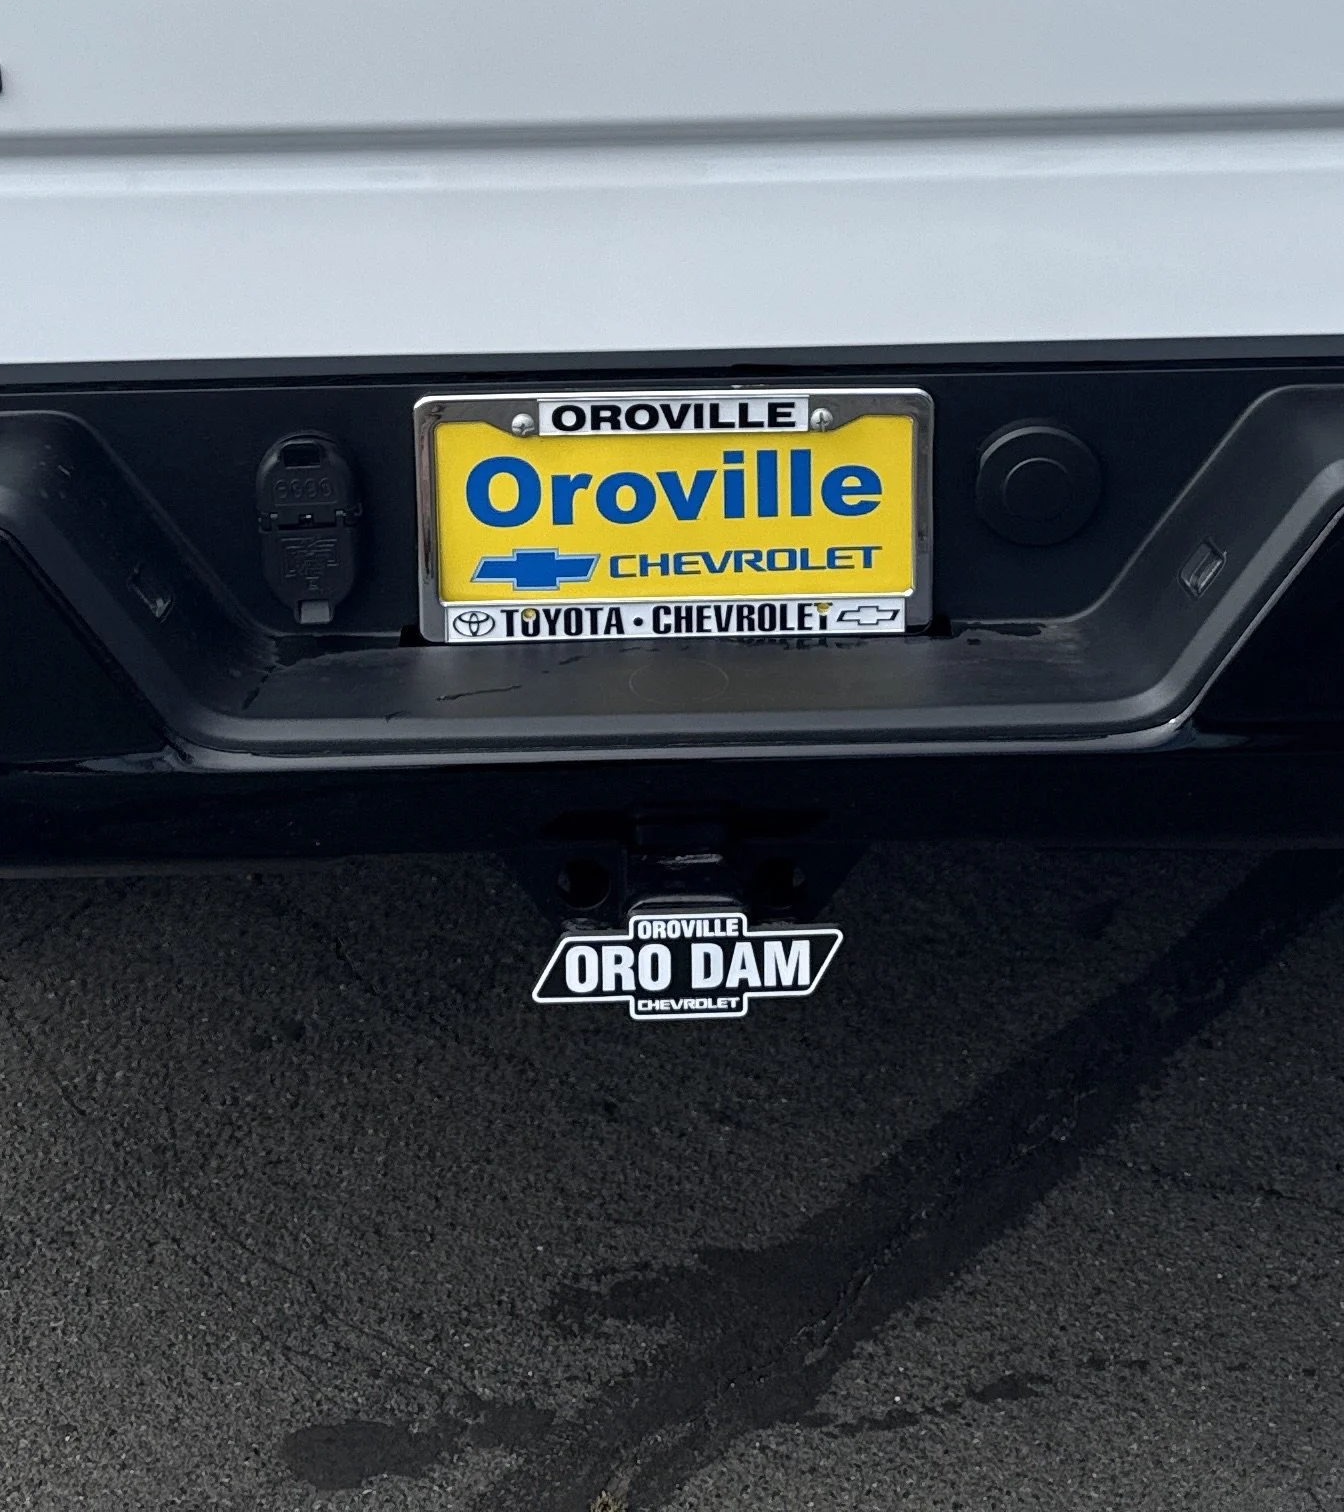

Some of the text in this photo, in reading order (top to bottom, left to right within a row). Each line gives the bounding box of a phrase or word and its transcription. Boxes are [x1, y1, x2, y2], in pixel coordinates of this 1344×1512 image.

[551, 401, 796, 432] OROVILLE
[465, 449, 883, 528] Oroville
[609, 545, 882, 579] CHEVROLET
[500, 601, 831, 638] TOYOTA CHEVROLET
[637, 918, 739, 939] OROVILLE
[565, 939, 811, 993] ORO DAM
[637, 997, 741, 1011] CHEVROLET
